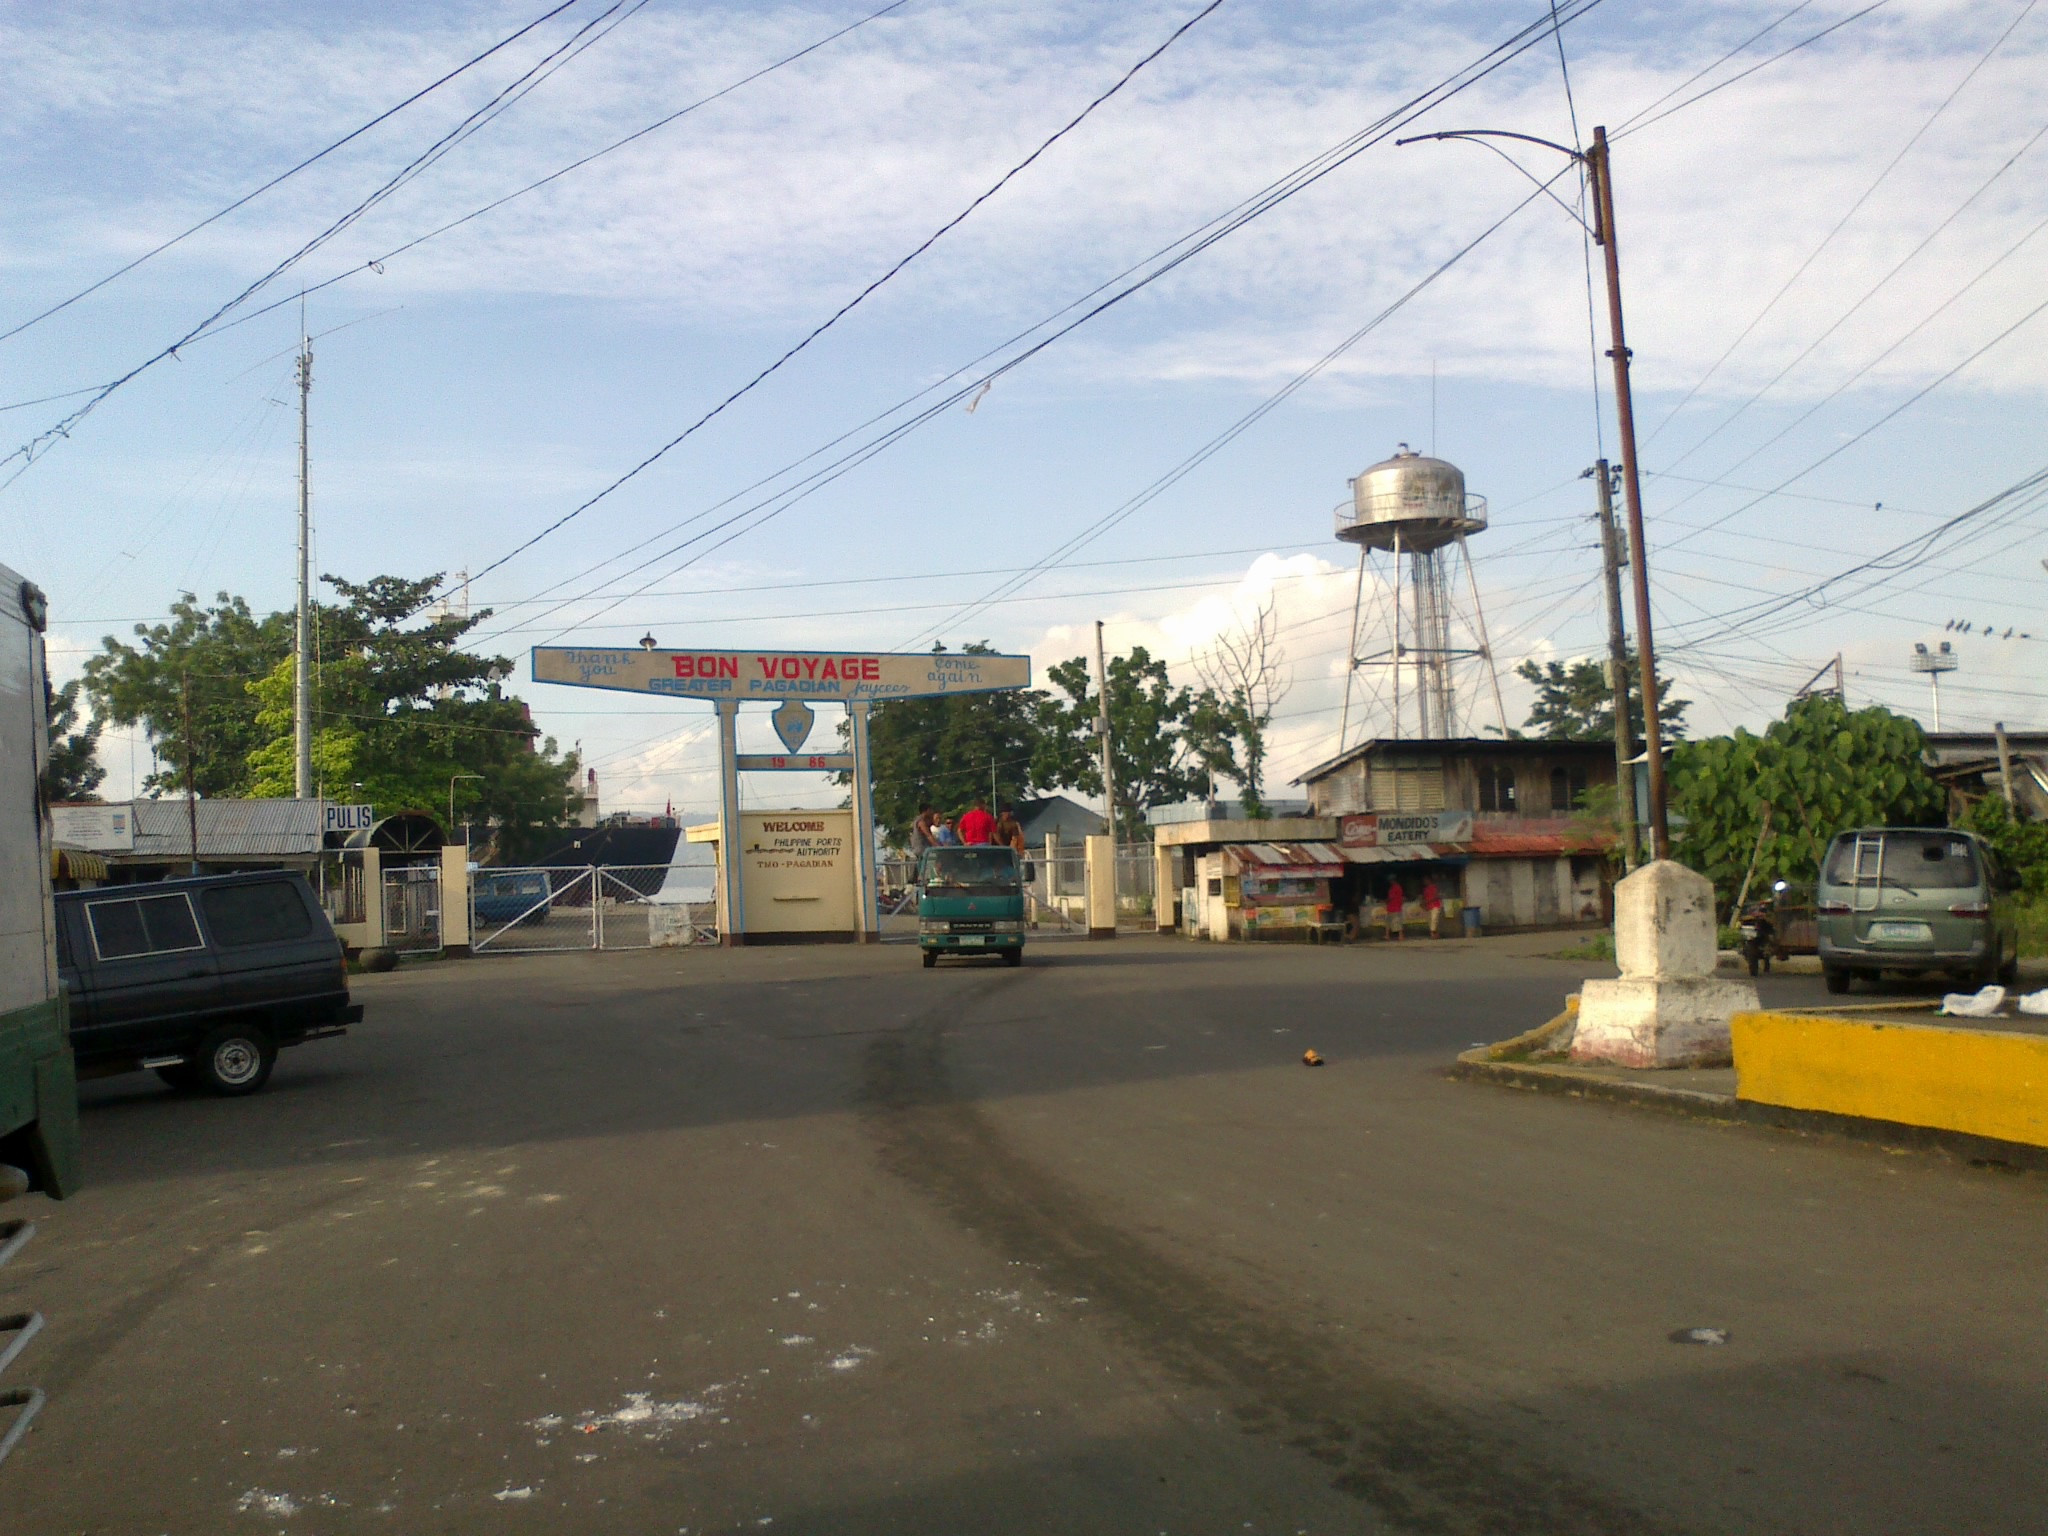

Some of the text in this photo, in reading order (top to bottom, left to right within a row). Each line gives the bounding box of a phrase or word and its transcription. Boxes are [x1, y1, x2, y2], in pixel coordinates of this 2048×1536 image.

[580, 664, 617, 682] you
[672, 656, 880, 680] BON VOYAGE
[649, 678, 733, 692] GREATER
[749, 679, 841, 693] PAGADIAN
[927, 670, 983, 690] again
[771, 757, 826, 768] 19 86
[327, 806, 371, 829] PULIS
[763, 821, 825, 833] WELCOME
[1387, 830, 1430, 842] EATERY
[774, 838, 842, 847] PHILIPPINE PORTS
[797, 847, 841, 857] AUTHORITY
[786, 860, 834, 868] PAGADIAN
